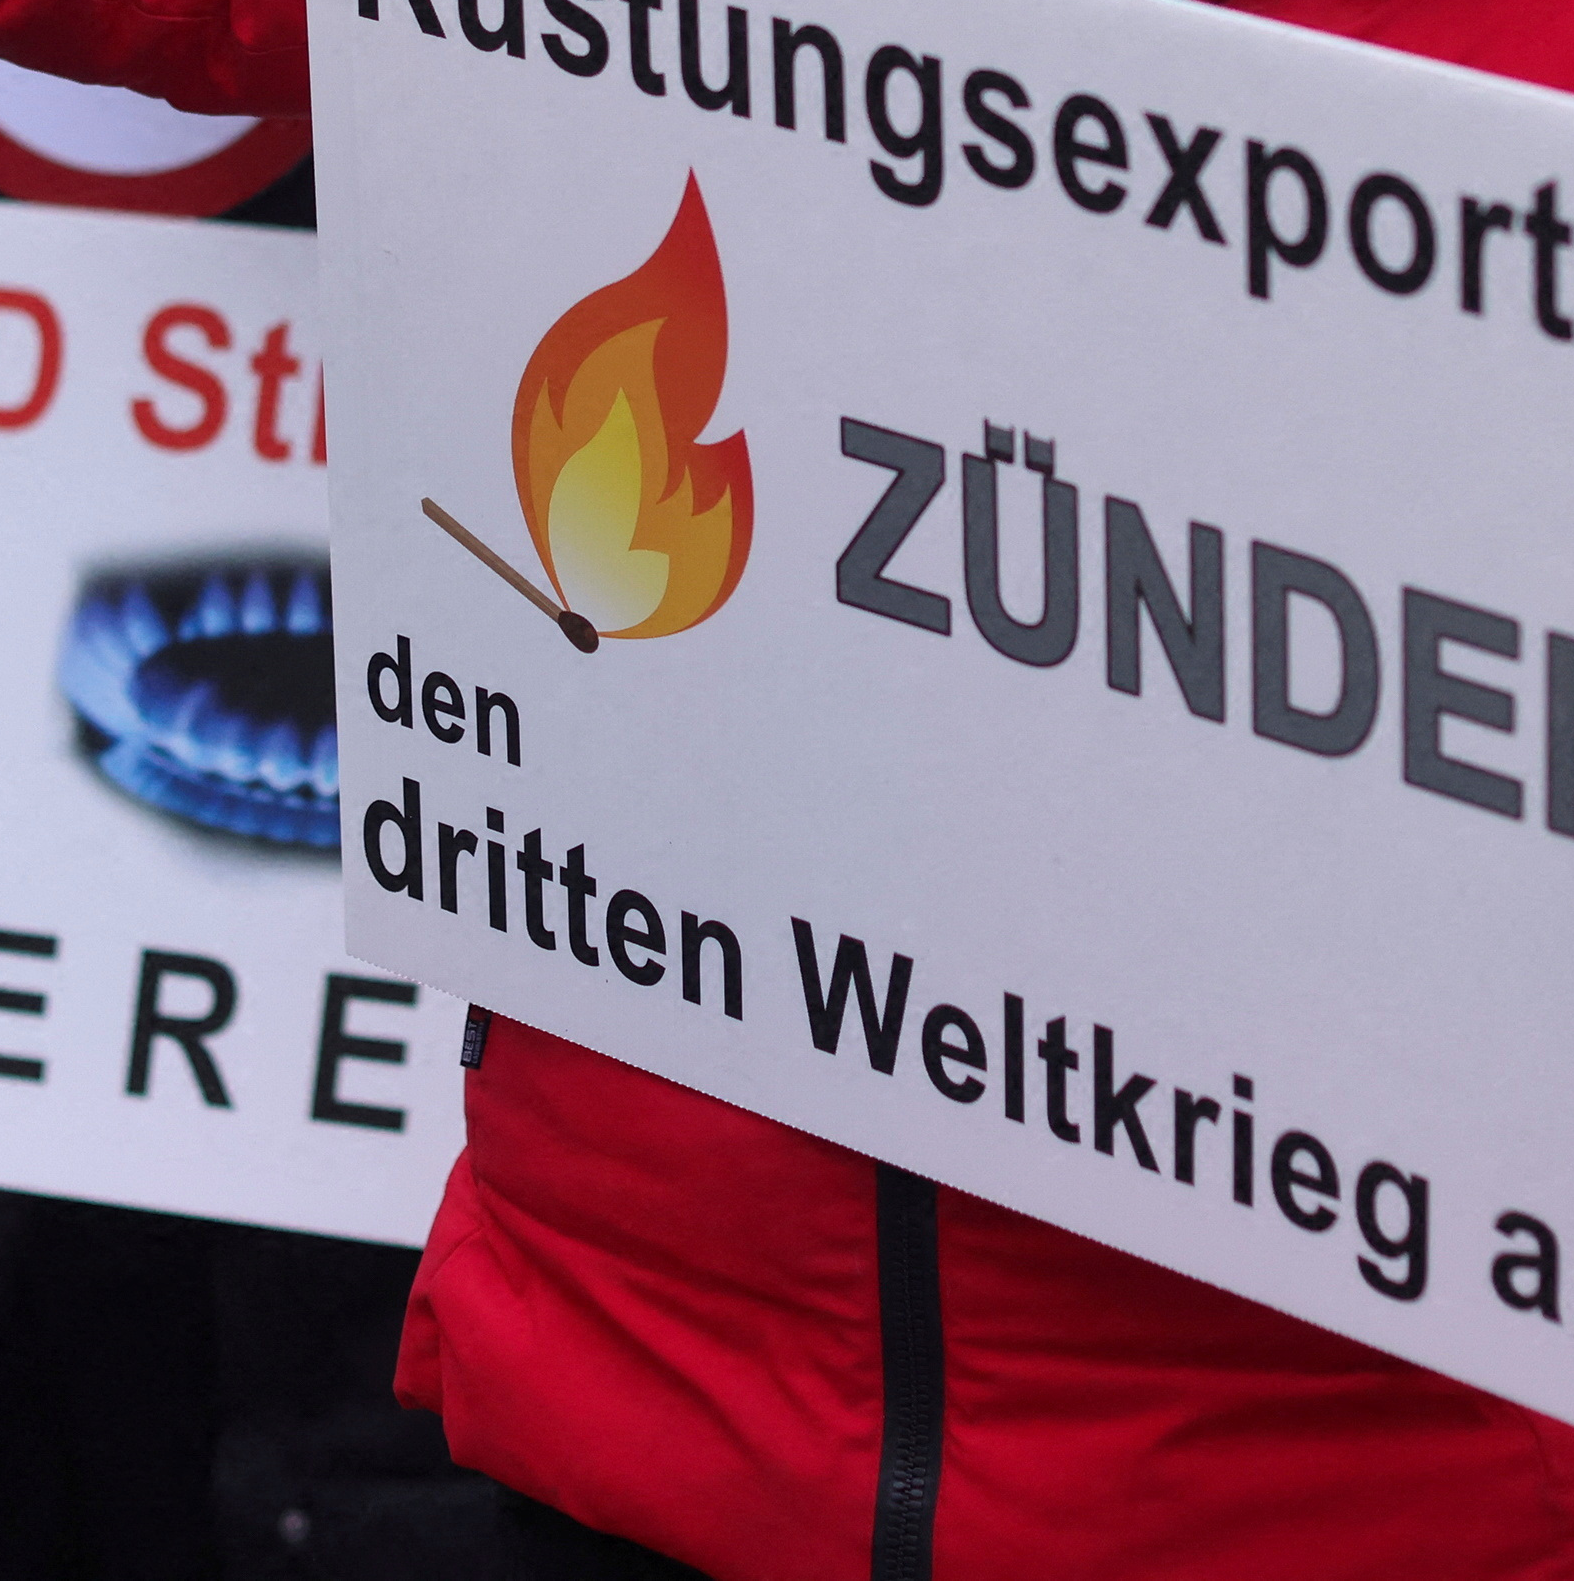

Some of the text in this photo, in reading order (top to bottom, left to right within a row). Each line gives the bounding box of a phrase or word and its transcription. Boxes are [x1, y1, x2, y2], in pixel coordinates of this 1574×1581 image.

[366, 633, 522, 769] den
[362, 776, 744, 1022] dritten
[790, 915, 1431, 1304] Weltkrieg
[462, 1021, 478, 1063] BEST
